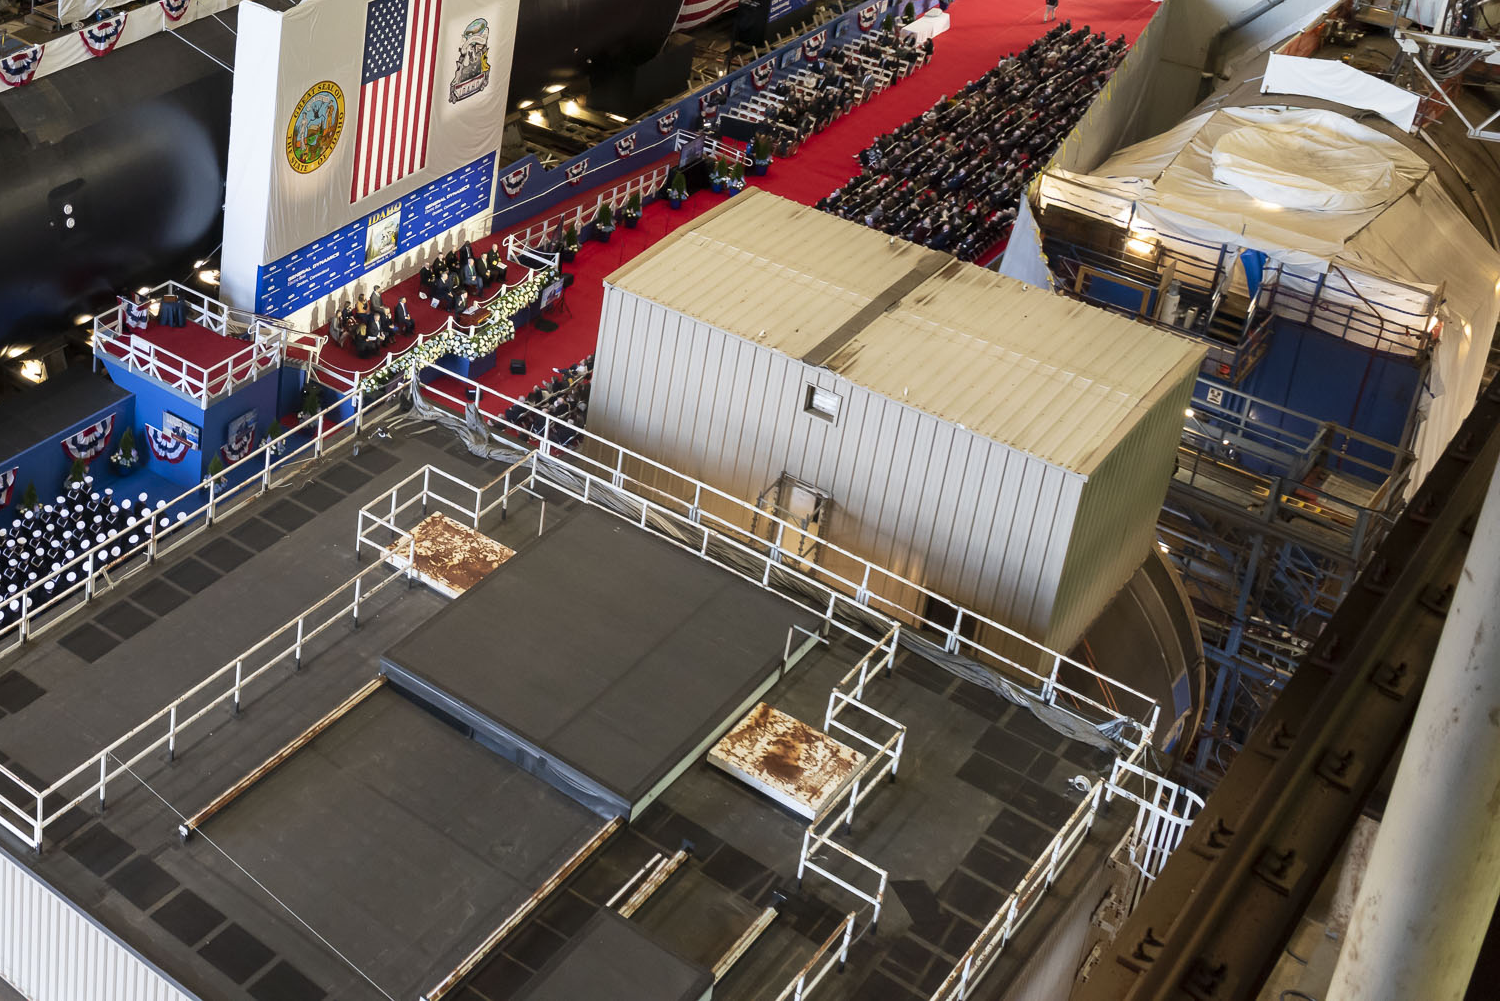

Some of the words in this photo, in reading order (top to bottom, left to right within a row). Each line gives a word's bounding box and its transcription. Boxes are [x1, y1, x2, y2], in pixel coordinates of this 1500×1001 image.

[294, 88, 316, 118] GREAT
[334, 88, 342, 99] OF
[290, 156, 308, 171] STATE
[318, 154, 327, 165] OF
[368, 202, 402, 226] IDAHO
[288, 266, 311, 282] GENERAL
[312, 252, 340, 269] DYNAMICS
